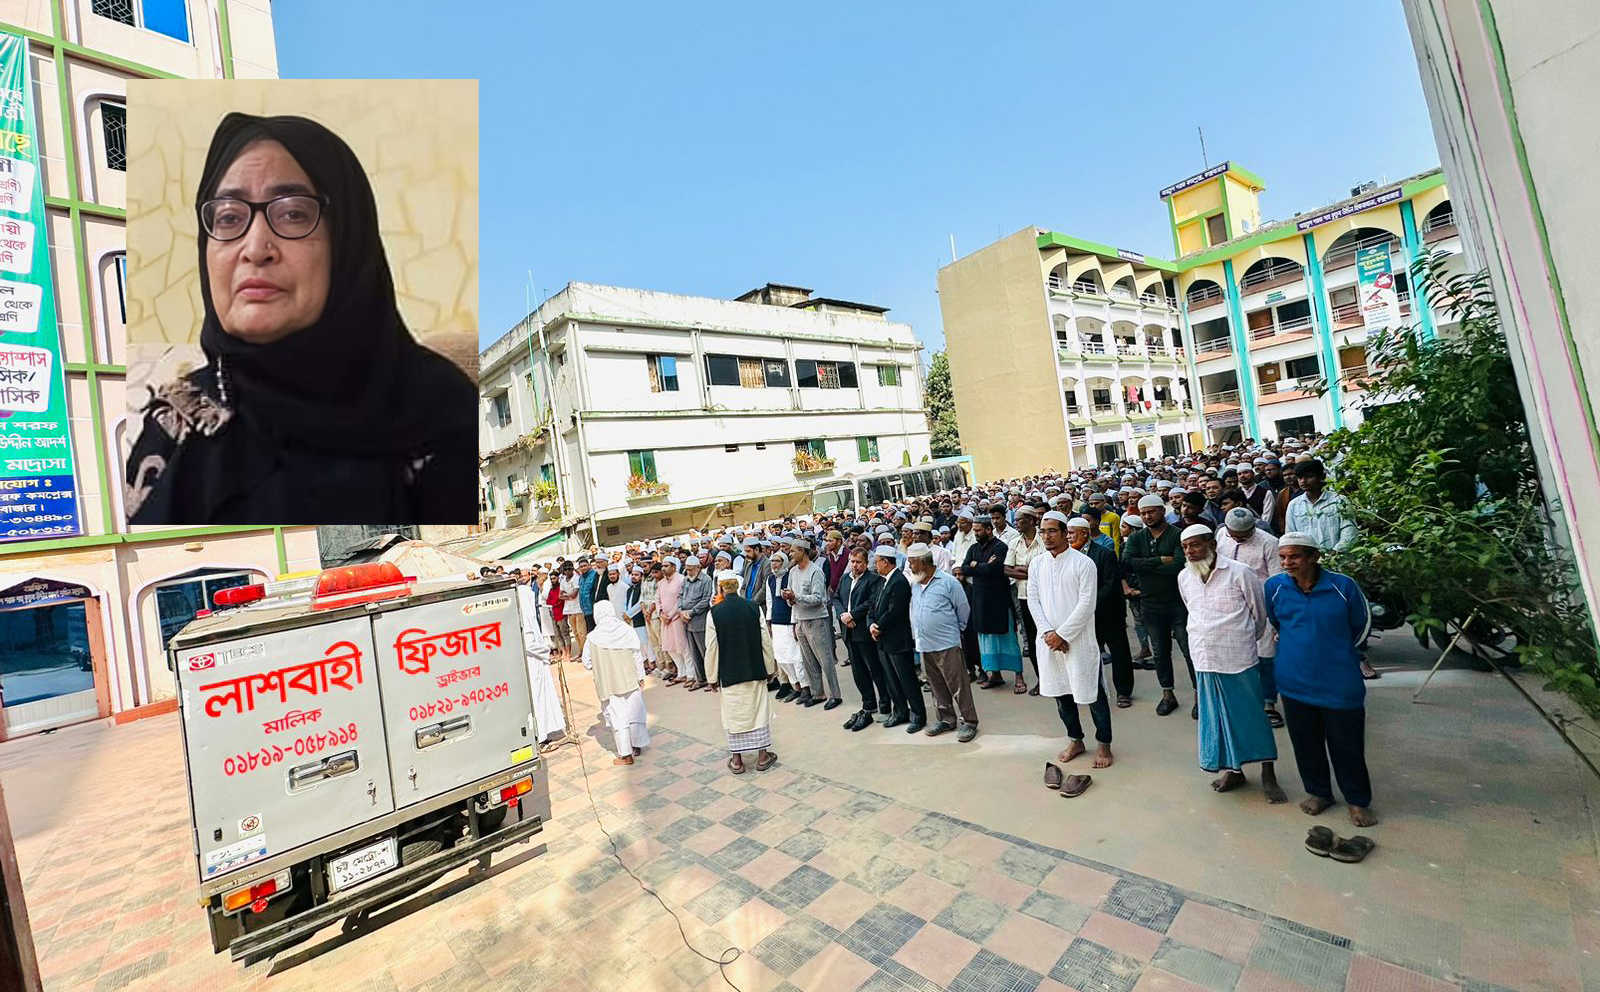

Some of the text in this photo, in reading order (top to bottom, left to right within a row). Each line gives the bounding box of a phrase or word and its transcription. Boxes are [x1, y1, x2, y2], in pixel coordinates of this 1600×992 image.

[4, 300, 33, 310] থেকে
[11, 421, 58, 431] শরফ
[34, 433, 66, 449] আদর্শ
[5, 458, 66, 473] মাদ্রাসা
[199, 621, 502, 717] লাশবাহী ফ্রিজার
[435, 666, 480, 688] ড্রাইভার
[409, 682, 509, 721] ০১৮২১-৯৭০২৩৭
[262, 708, 322, 735] মালিক
[224, 722, 359, 776] ০১৮১৯-০৫৮৯১৪
